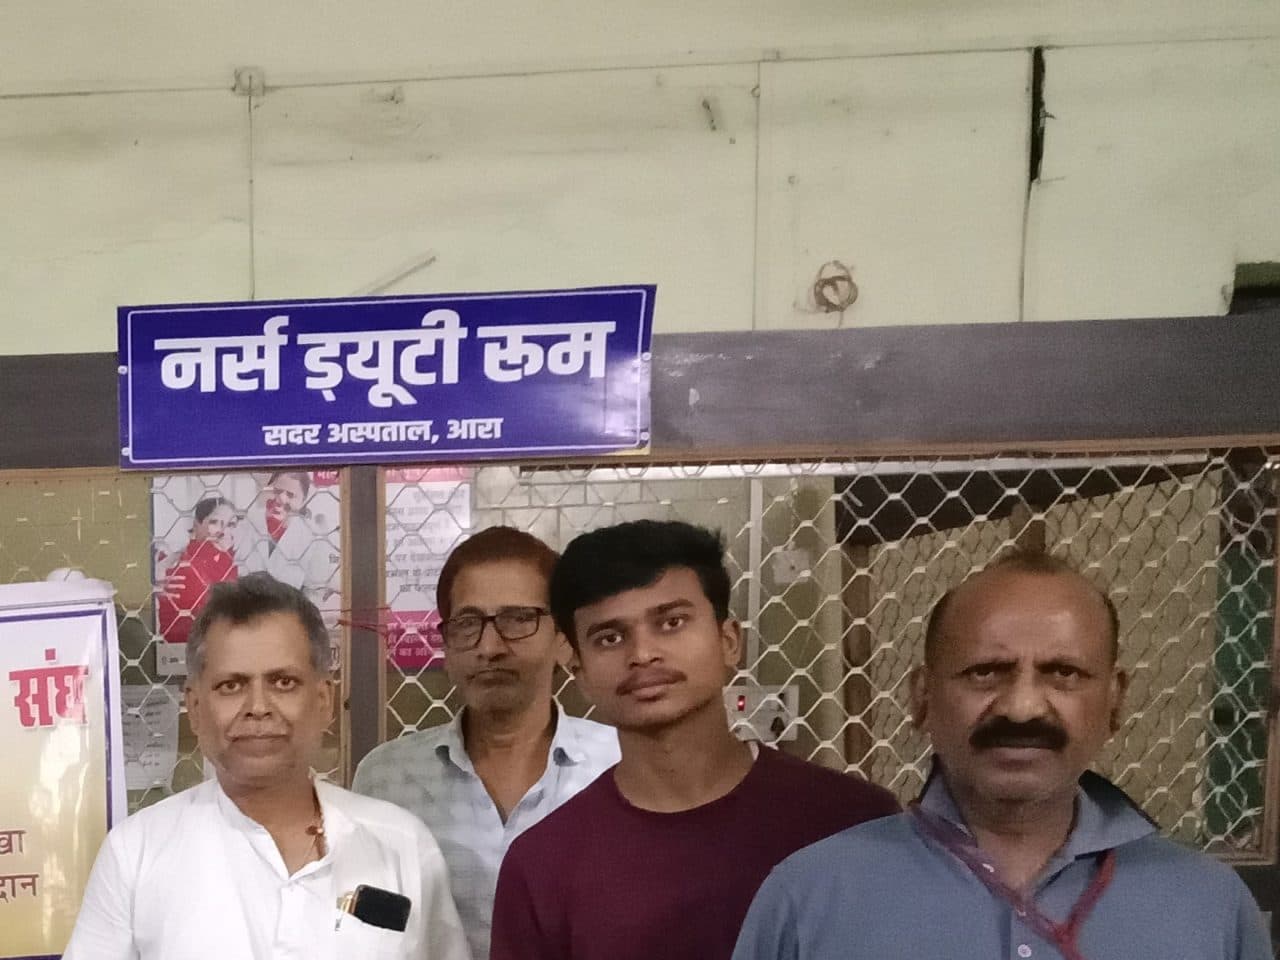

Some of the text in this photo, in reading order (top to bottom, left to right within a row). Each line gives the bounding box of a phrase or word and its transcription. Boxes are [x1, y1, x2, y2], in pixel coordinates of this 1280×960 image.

[154, 308, 616, 408] नर्स ड्यूटी रूम
[262, 417, 504, 446] सदर अस्पताल, आरा
